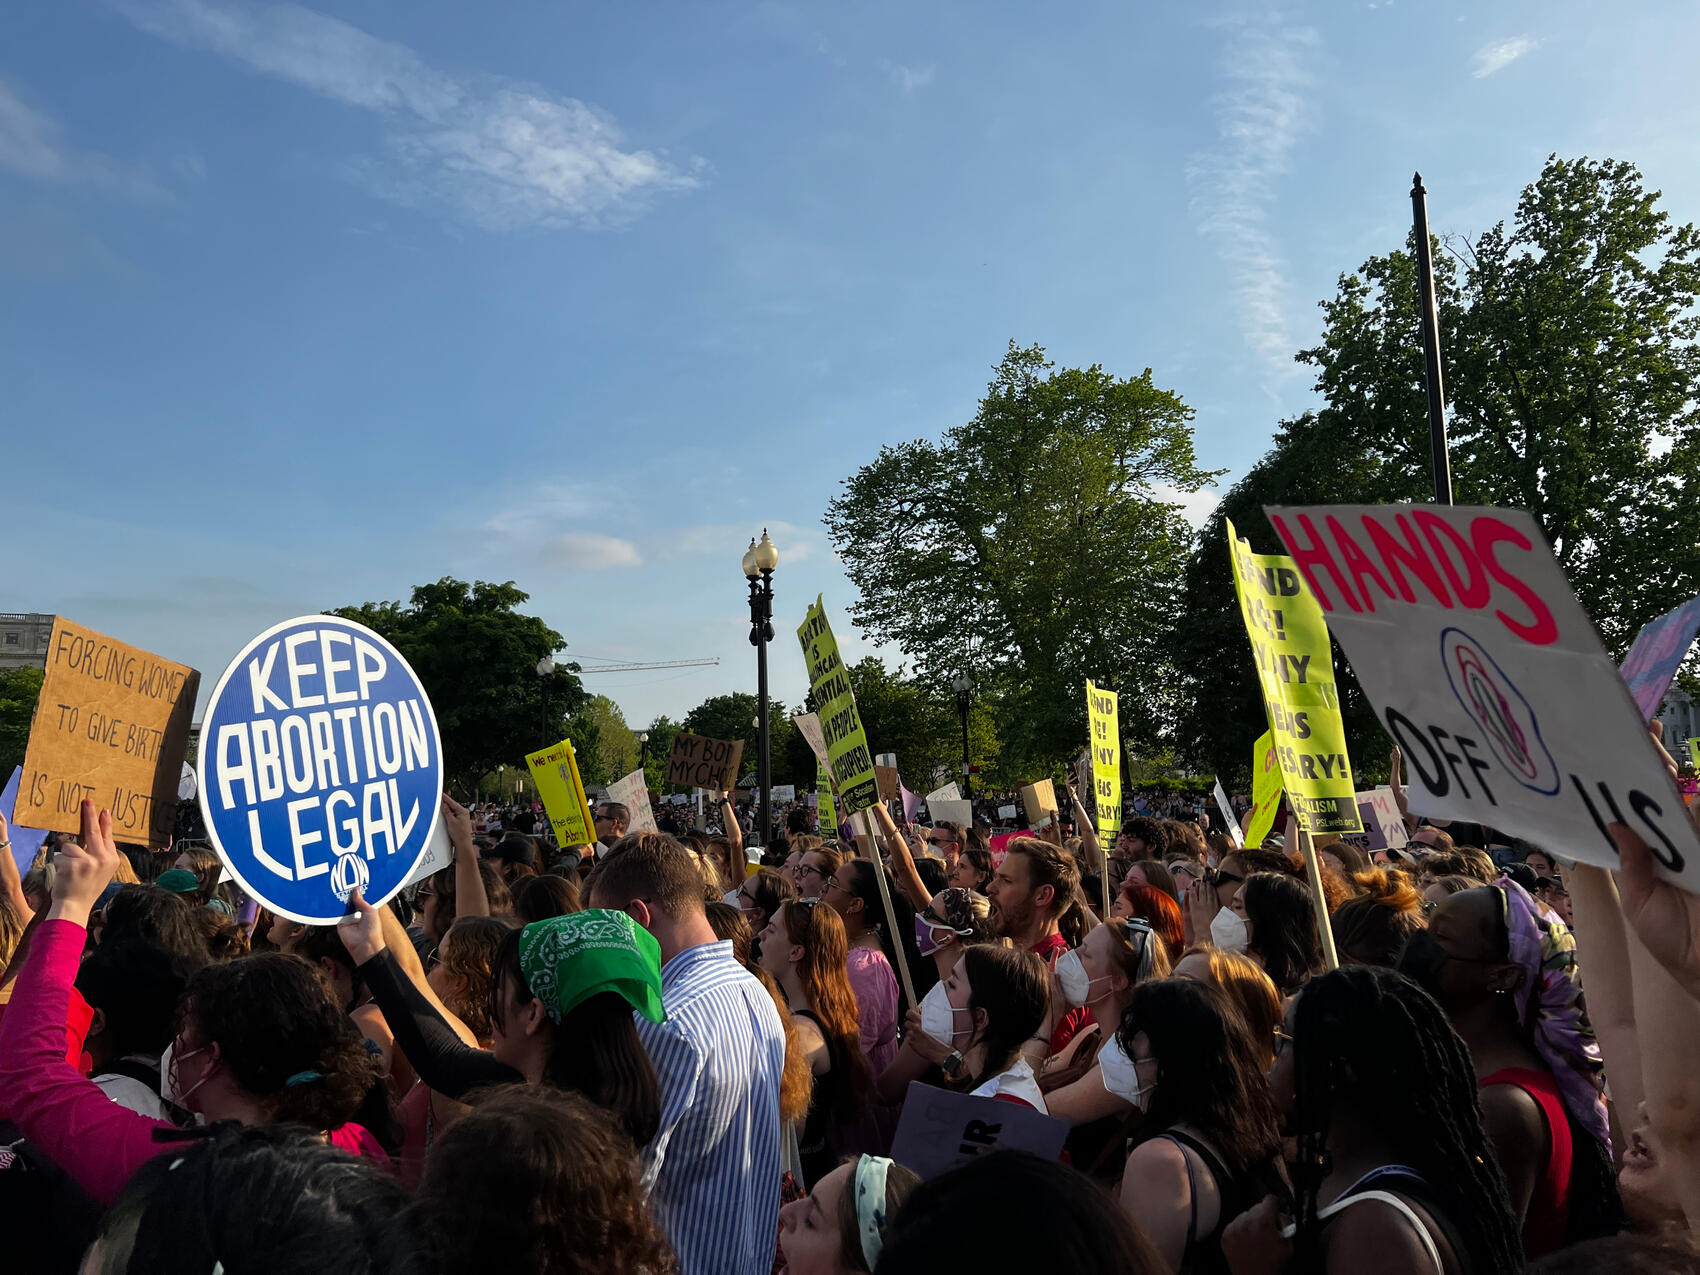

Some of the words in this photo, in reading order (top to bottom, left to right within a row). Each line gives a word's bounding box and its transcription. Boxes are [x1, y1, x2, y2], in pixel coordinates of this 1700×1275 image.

[1272, 511, 1559, 645] HANDS
[55, 630, 136, 689] FORCING
[248, 630, 387, 713] KEEP
[57, 703, 79, 734] TO
[87, 712, 122, 747] GIVE
[673, 736, 699, 758] MY
[831, 704, 858, 742] PEOPLE
[216, 699, 429, 809] ABORTION
[668, 760, 695, 782] MY
[1385, 706, 1497, 806] OFF
[29, 770, 48, 807] IS
[248, 778, 419, 881] LEGAL
[1569, 773, 1685, 873] US
[331, 852, 369, 895] NOW
